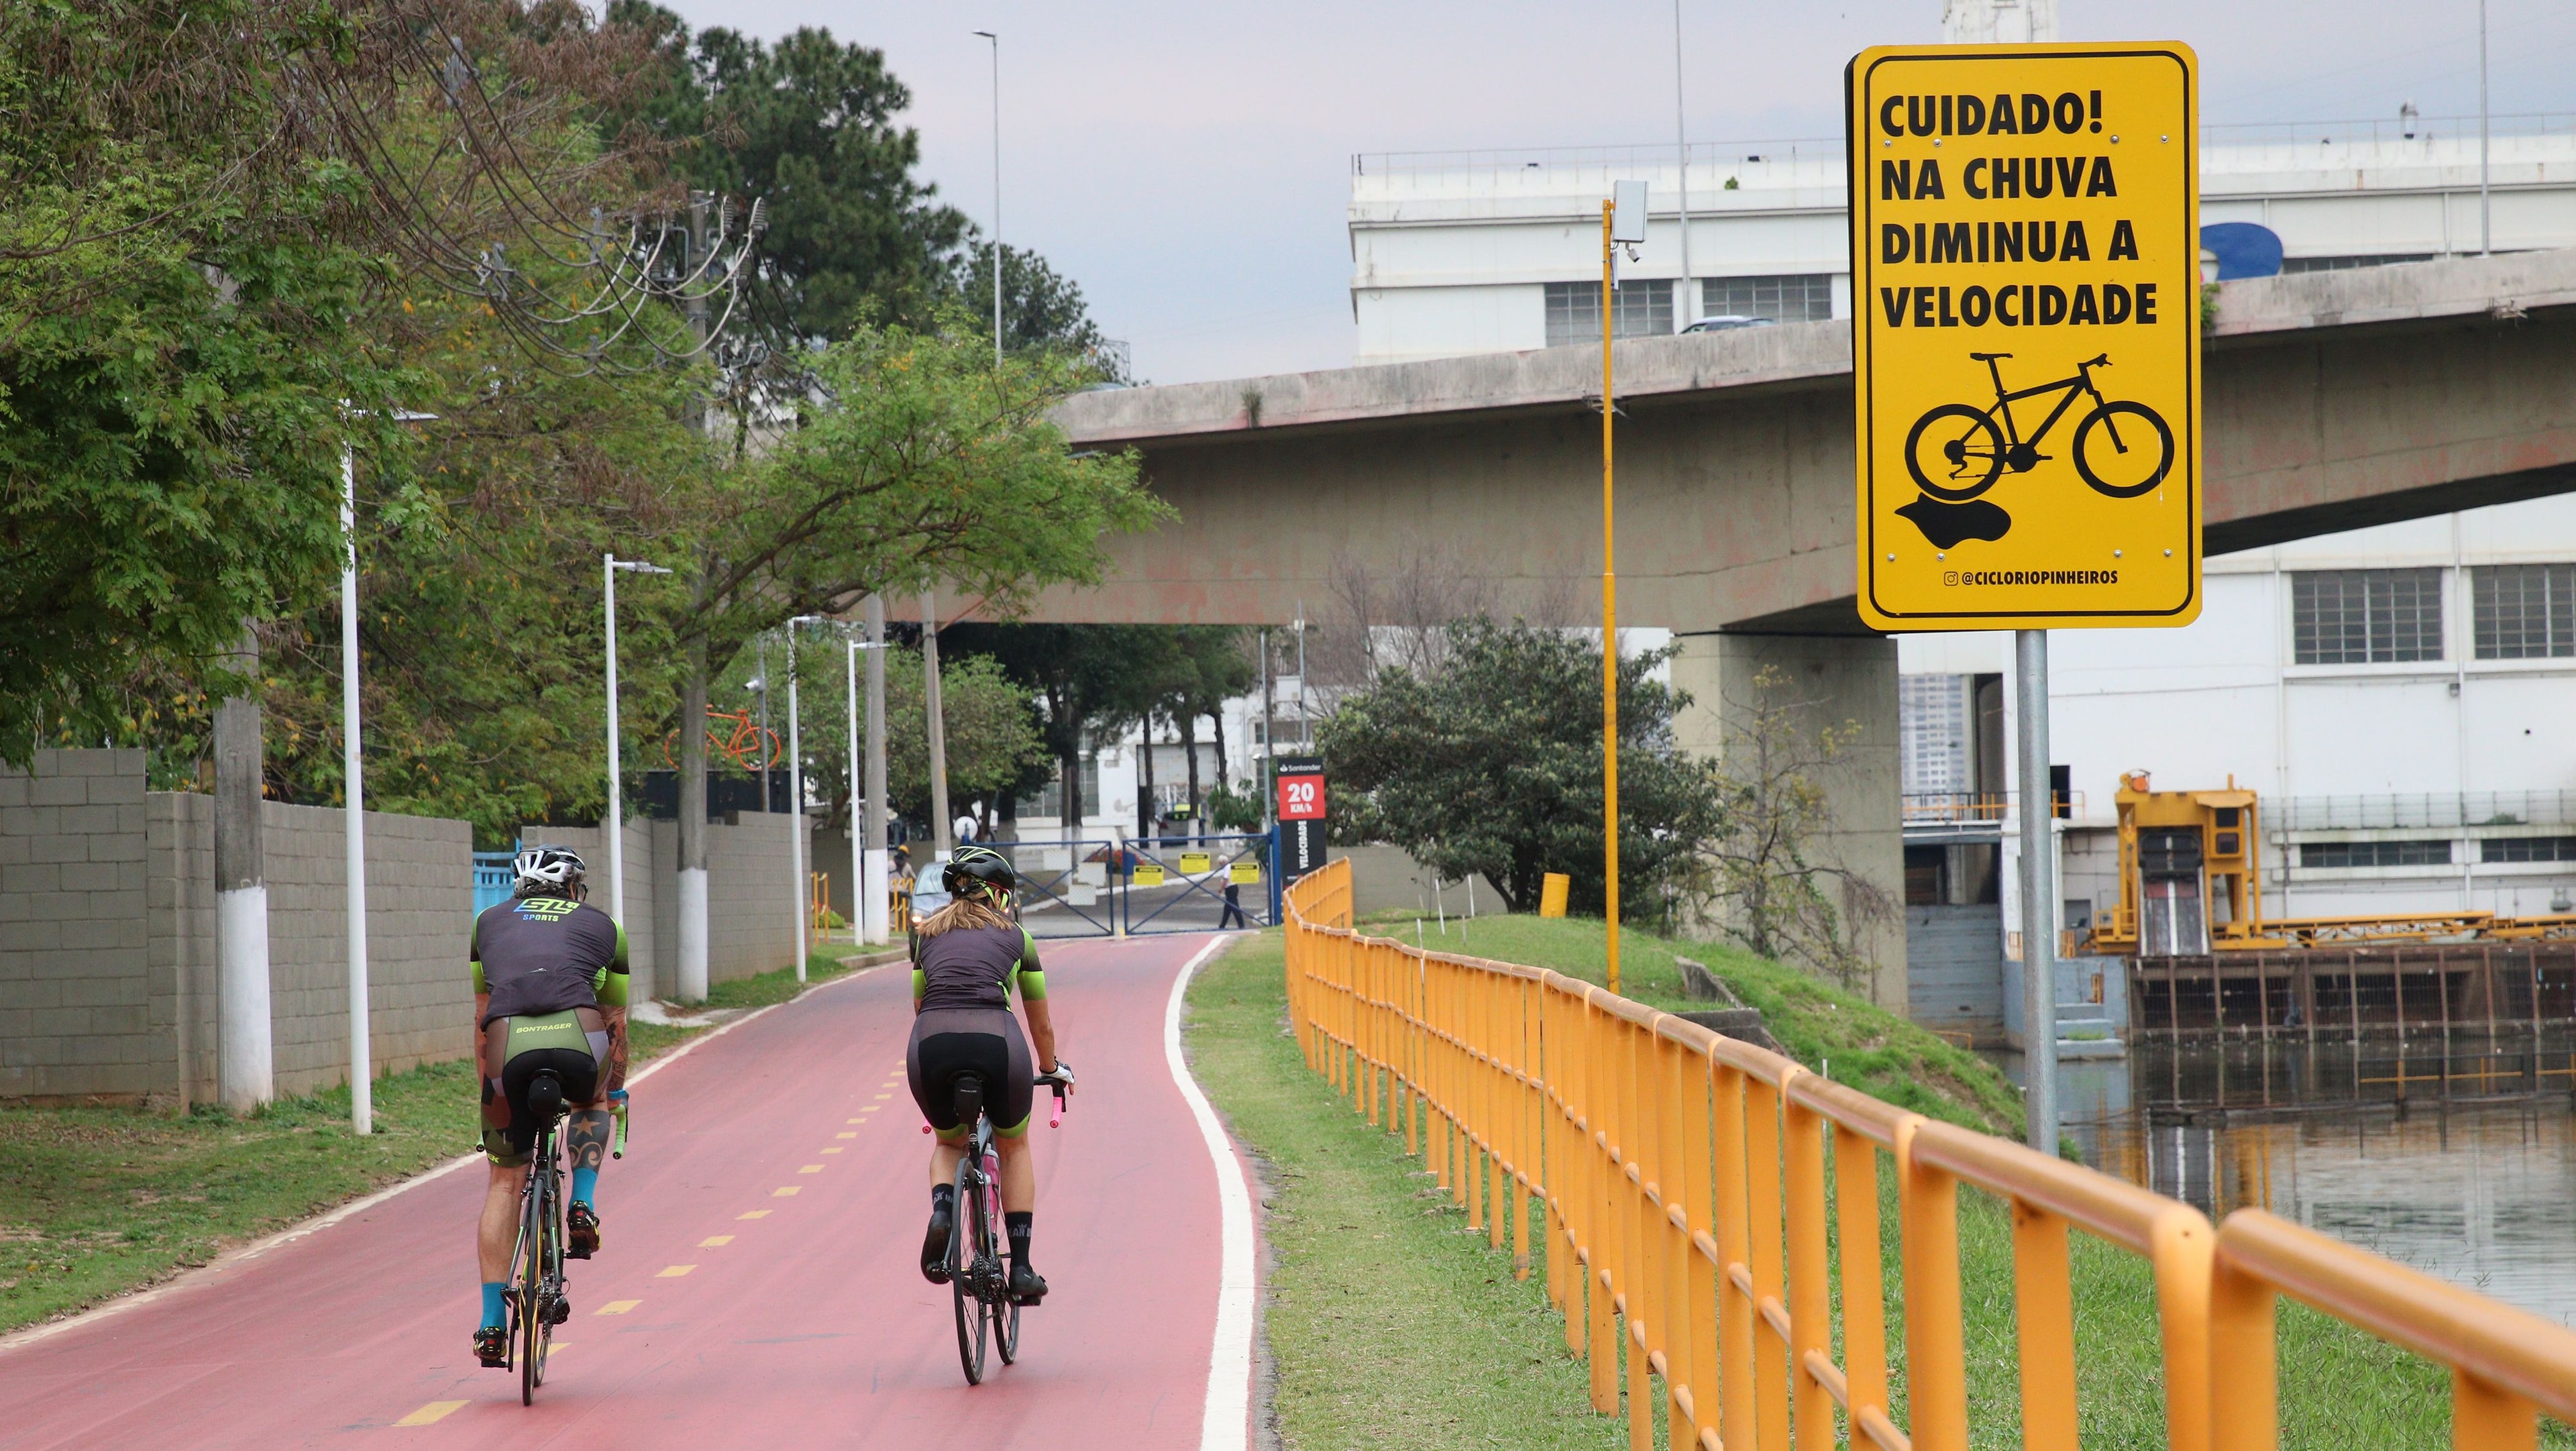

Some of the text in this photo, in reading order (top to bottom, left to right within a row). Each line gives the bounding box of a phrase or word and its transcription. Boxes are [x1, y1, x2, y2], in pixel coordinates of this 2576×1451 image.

[1880, 91, 2102, 137] CUIDADO!
[1881, 157, 2117, 201] NA CHUVA
[1882, 220, 2139, 264] DIMINUA A
[1880, 283, 2157, 327] VELOCIDADE
[1962, 570, 2118, 586] @CICLORIOPINHEIROS
[1289, 764, 1321, 772] Santander
[1287, 782, 1315, 803] 20
[1290, 803, 1313, 813] KM/h
[1298, 820, 1309, 869] VELOCIDADE
[523, 914, 559, 922] SPORTS
[516, 1022, 572, 1034] BONTRAGER
